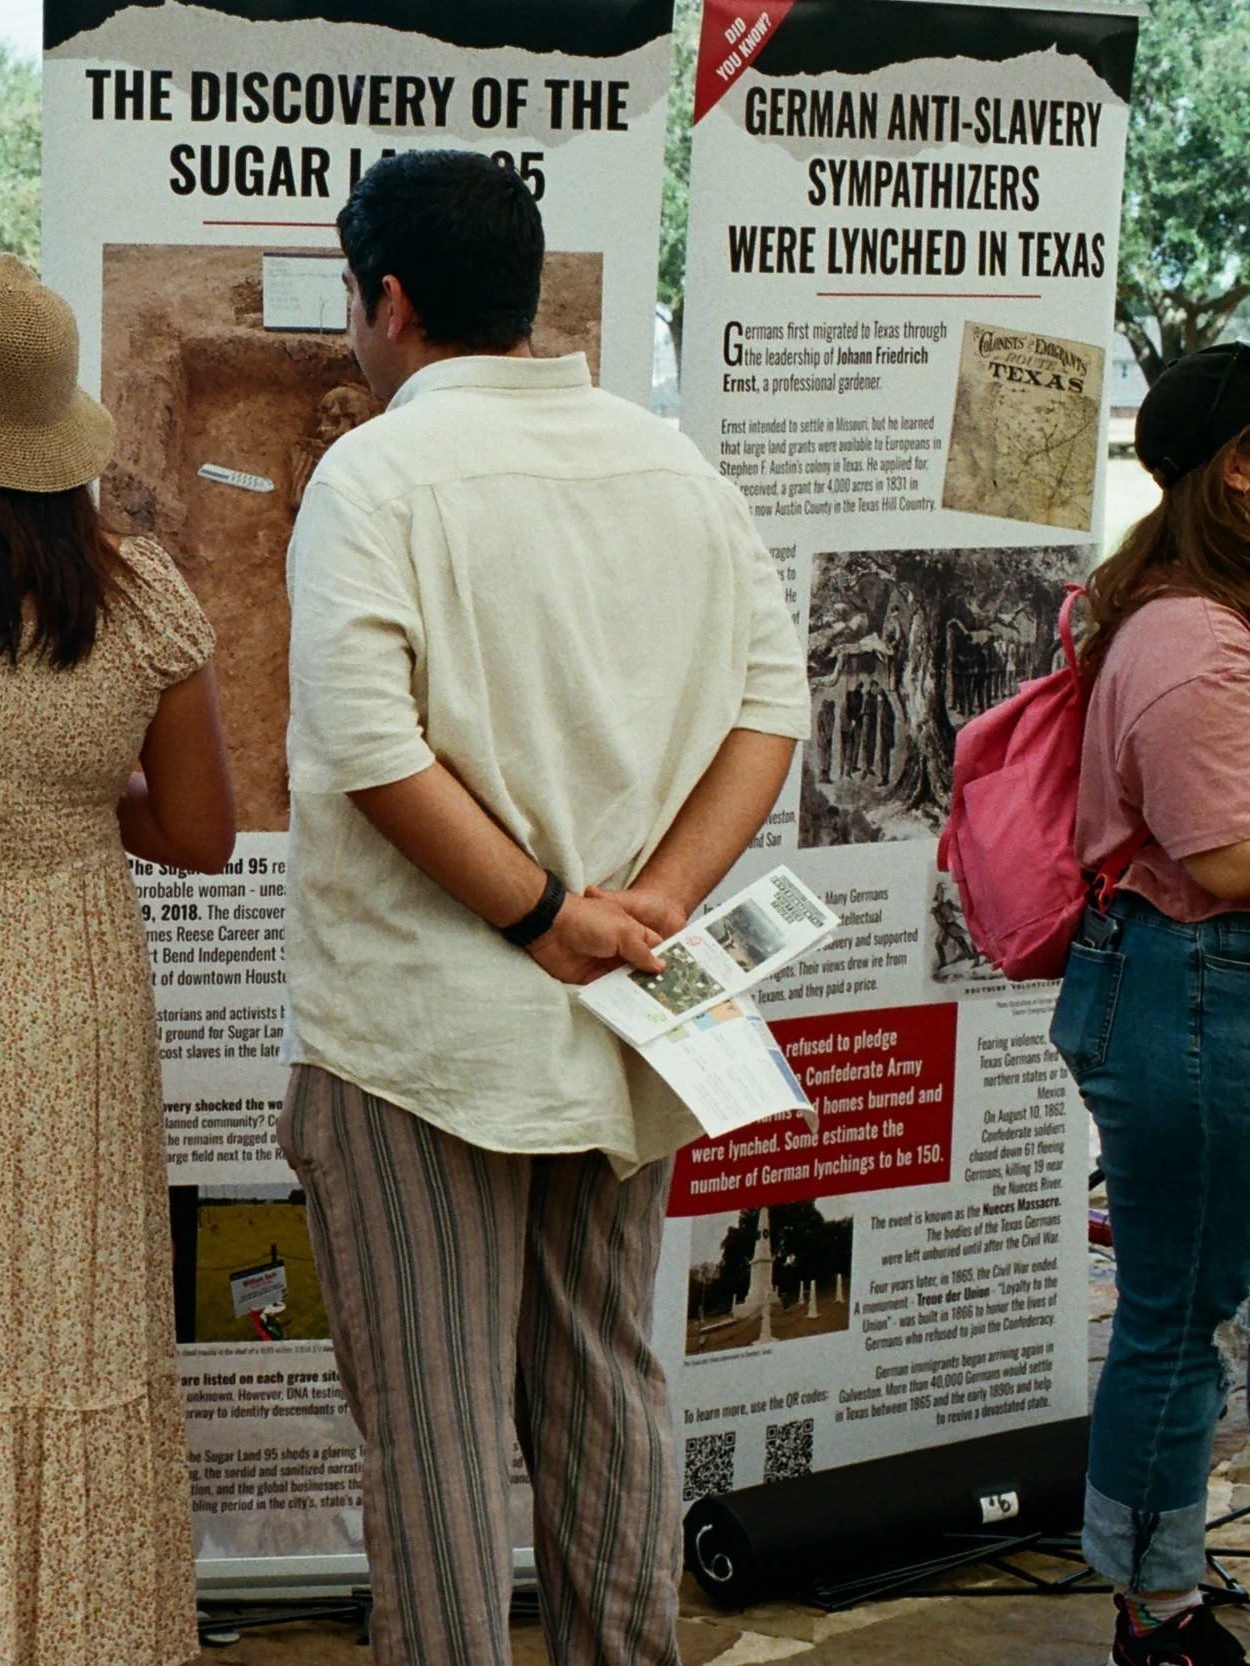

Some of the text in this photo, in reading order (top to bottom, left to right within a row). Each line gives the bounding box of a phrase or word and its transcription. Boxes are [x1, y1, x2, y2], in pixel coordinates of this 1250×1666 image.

[723, 16, 747, 46] DID
[715, 11, 772, 82] YOU KNOW?
[85, 69, 631, 132] THE DISCOVERY OF THE
[744, 86, 1102, 148] GERMAN ANTI-SLAVERY
[169, 144, 331, 199] SUGAR
[808, 158, 1040, 212] SYMPATHIZERS
[728, 225, 1106, 278] WERE LYNCHED IN TEXAS
[787, 321, 947, 343] first migrated Texas through
[744, 346, 928, 369] the leadership Johann Friedrich
[723, 372, 882, 396] Ernst, professional gardener.
[989, 361, 1084, 394] TEXAS
[721, 415, 935, 434] Ernst learned
[788, 436, 931, 457] grants Europeans
[719, 460, 758, 479] Stephen
[775, 501, 802, 516] Austin
[198, 885, 246, 898] woman
[850, 888, 888, 903] Germans
[161, 904, 230, 921] 2018. The
[176, 926, 259, 942] Reese Career
[873, 928, 918, 947] supported
[163, 947, 276, 965] Bend Independent
[177, 970, 242, 986] downtown
[205, 1005, 278, 1022] and activists
[166, 1025, 261, 1043] ground for Sugar
[786, 1028, 898, 1058] refused to pledge
[977, 1036, 1009, 1053] Fearing
[1004, 1052, 1041, 1068] Germans
[806, 1057, 923, 1087] Confederate Army
[983, 1072, 1020, 1087] northern
[195, 1099, 264, 1112] shocked the
[823, 1091, 864, 1116] homes
[868, 1087, 914, 1110] burned
[918, 1083, 943, 1104] and
[201, 1115, 265, 1130] community?
[997, 1107, 1027, 1124] August
[183, 1132, 267, 1147] remains dragged
[692, 1120, 904, 1163] were lynched. Some estimate the
[981, 1126, 1032, 1144] Confederate
[191, 1149, 239, 1163] field next
[690, 1144, 944, 1195] number of German lynchings to be 150.
[982, 1196, 1062, 1217] Nueces Massacre.
[203, 1372, 319, 1386] listed each grave
[230, 1402, 335, 1419] identify descendants
[205, 1447, 310, 1465] Sugar Land sheds
[224, 1465, 256, 1479] sordid
[257, 1479, 345, 1496] global businesses
[221, 1499, 253, 1514] period
